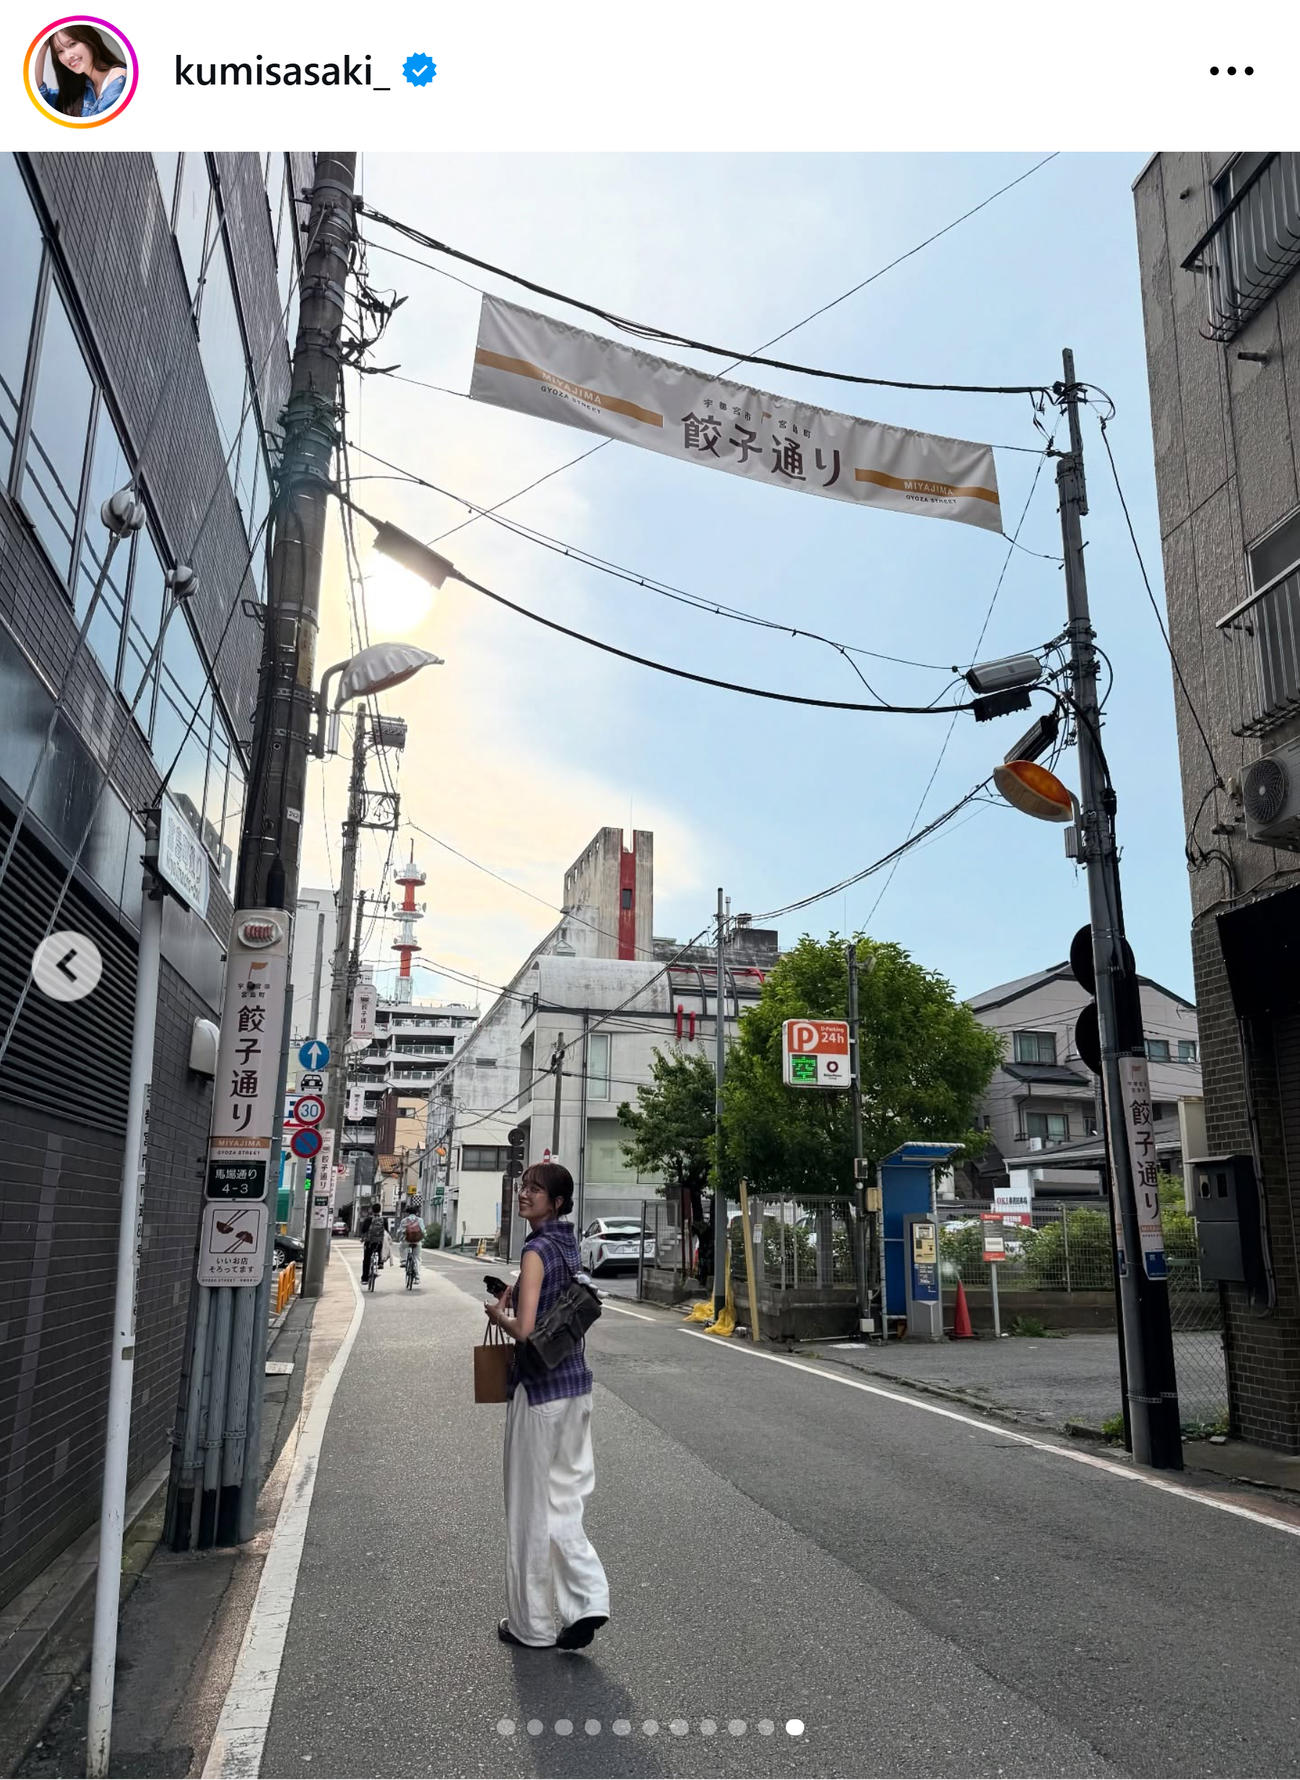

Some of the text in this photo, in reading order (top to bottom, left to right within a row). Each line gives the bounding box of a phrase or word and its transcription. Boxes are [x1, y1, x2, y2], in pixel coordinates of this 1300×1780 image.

[541, 372, 602, 404] MIYAJIMA
[540, 385, 601, 415] GYOZA STREET
[704, 398, 751, 421] 宇都宮市
[681, 412, 841, 487] 餃子通り
[904, 481, 954, 496] MIYAJIMA
[905, 494, 957, 505] GYOZA STREET
[821, 1032, 845, 1044] 24h
[230, 1004, 266, 1132] 餃子通り
[300, 1103, 319, 1118] 30
[1129, 1099, 1160, 1220] 餃子通り
[222, 1183, 249, 1194] 4-3
[216, 1257, 249, 1265] いいお店
